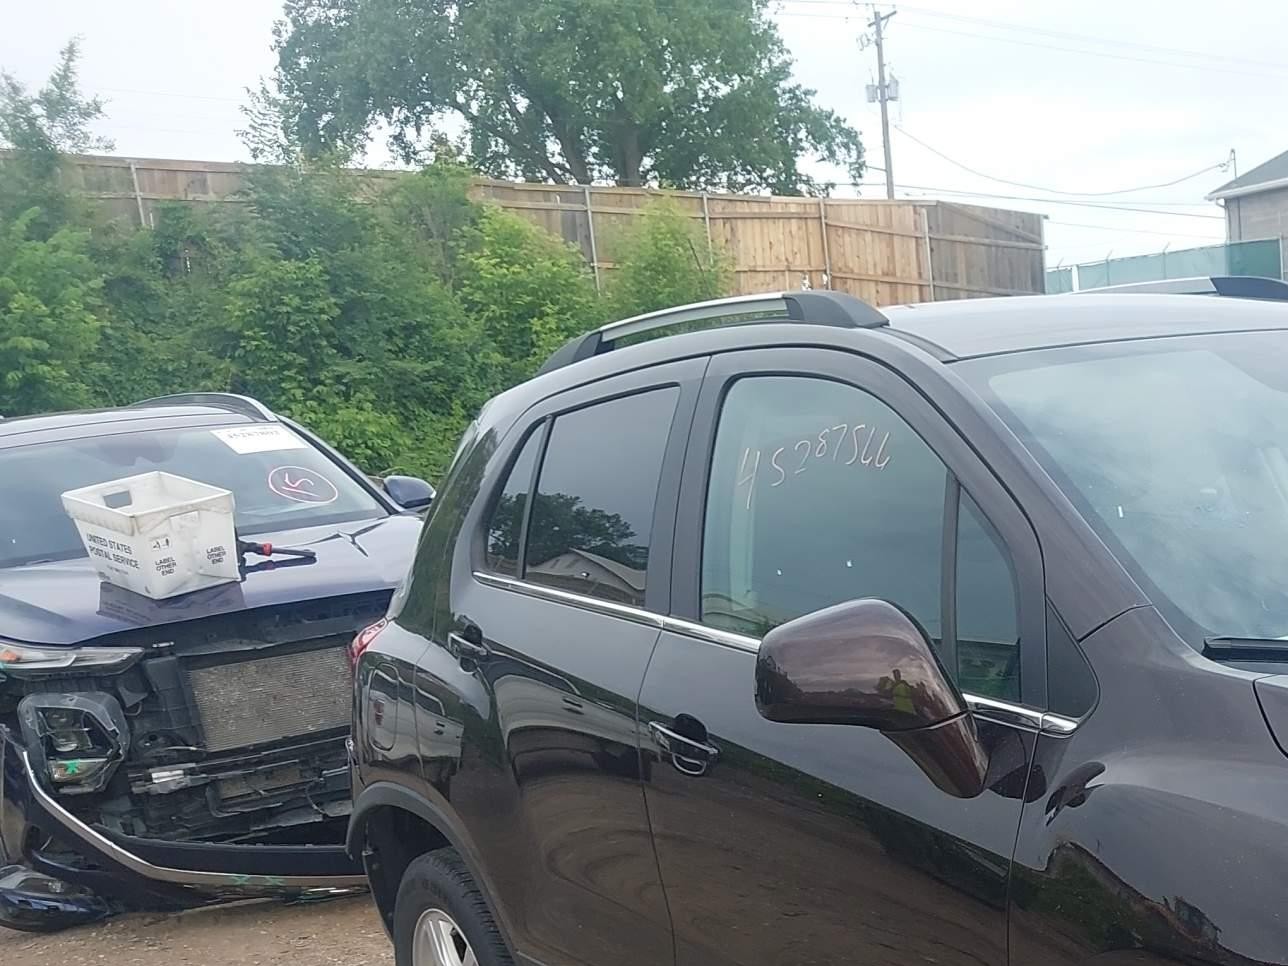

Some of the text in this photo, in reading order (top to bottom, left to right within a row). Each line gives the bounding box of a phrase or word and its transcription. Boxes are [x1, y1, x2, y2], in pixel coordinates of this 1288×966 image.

[86, 533, 133, 555] UNITED STATES
[206, 546, 224, 554] LABEL
[207, 551, 226, 560] OTHER
[112, 553, 140, 569] SERVICE
[155, 557, 176, 566] LABEL
[211, 557, 224, 565] END
[156, 562, 177, 572] OTHER
[161, 568, 175, 576] END
